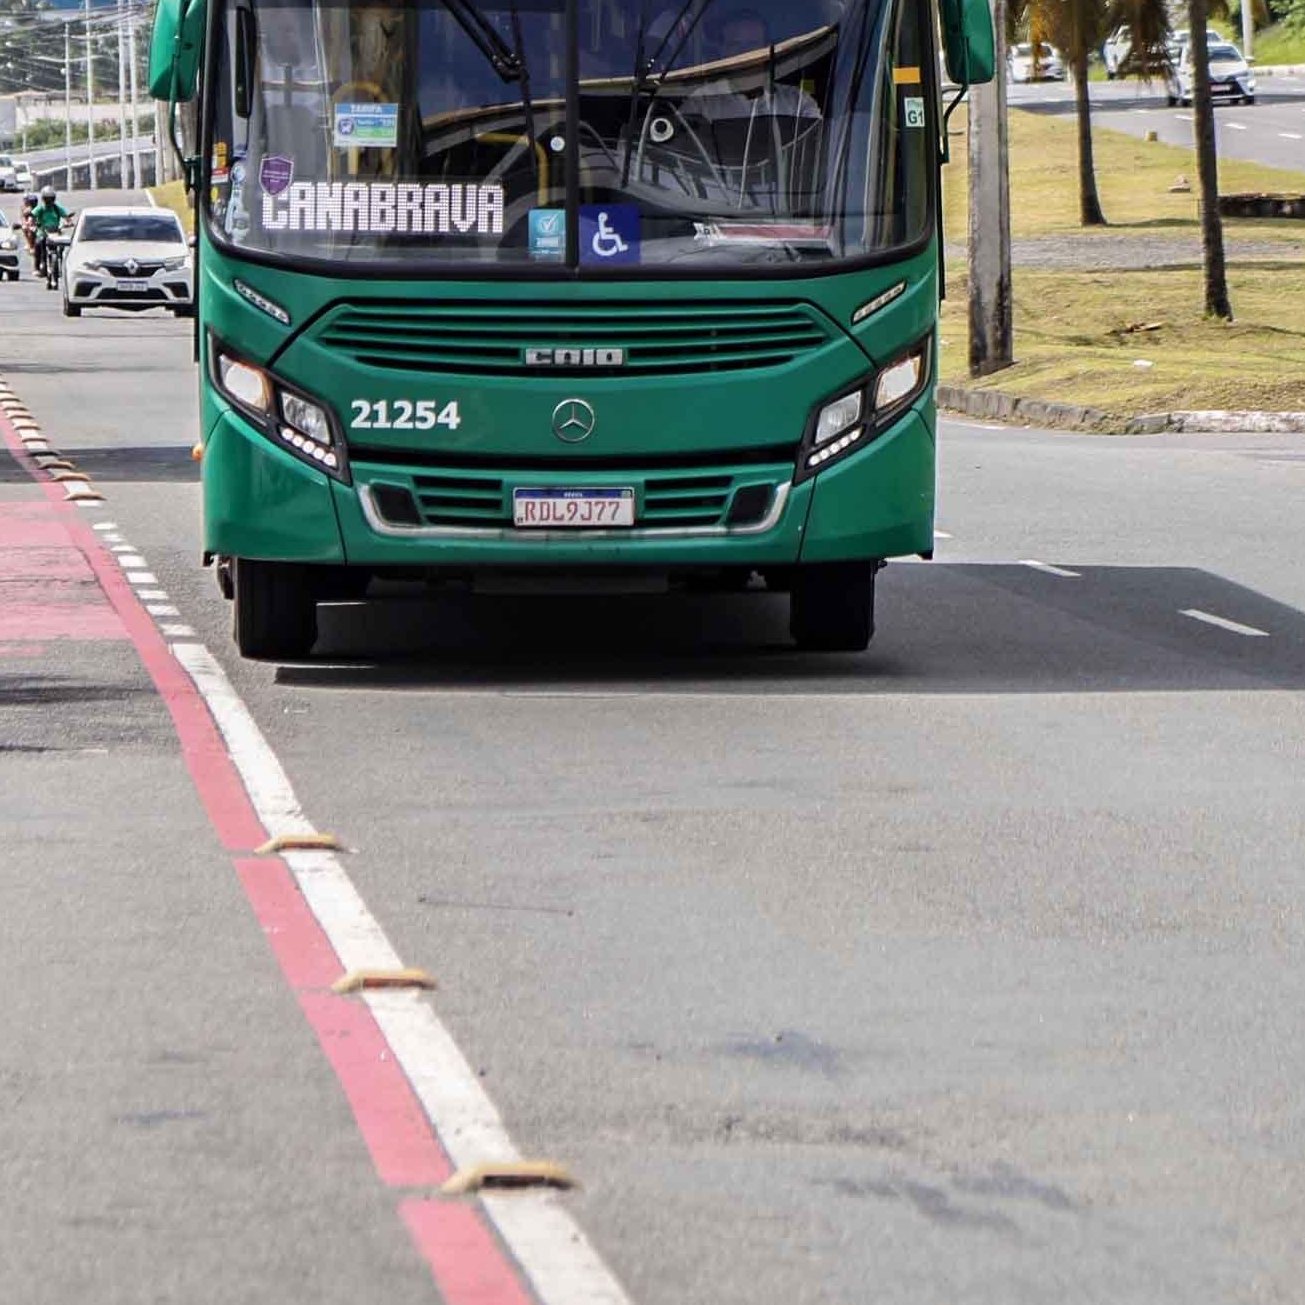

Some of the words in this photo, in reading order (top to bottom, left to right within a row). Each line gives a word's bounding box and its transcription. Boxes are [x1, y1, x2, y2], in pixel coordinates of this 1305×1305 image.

[907, 109, 924, 125] G1
[261, 181, 504, 233] CANABRAVA
[350, 399, 462, 430] 21254
[524, 500, 621, 522] RDL9J77
